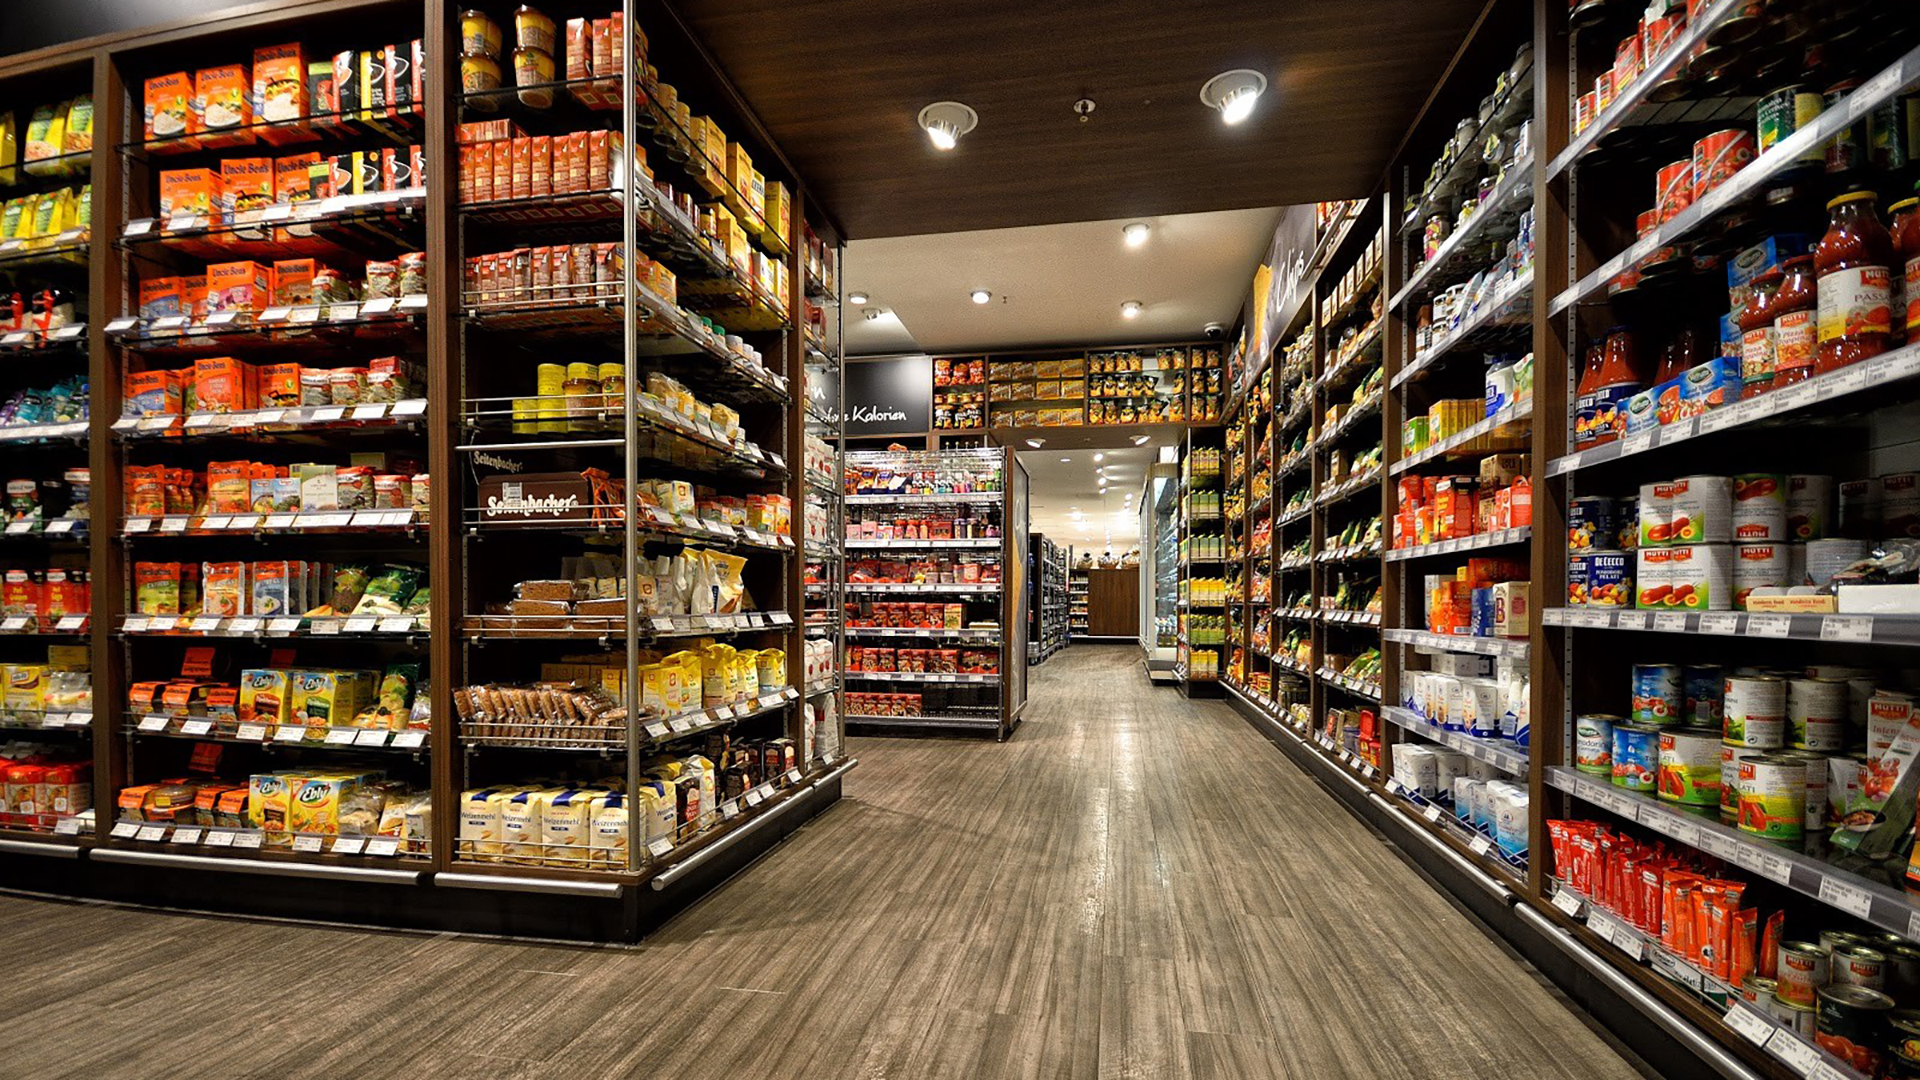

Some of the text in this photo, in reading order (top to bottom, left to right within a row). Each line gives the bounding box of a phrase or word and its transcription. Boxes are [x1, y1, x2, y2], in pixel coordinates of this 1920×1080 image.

[224, 163, 246, 174] Uncle
[852, 404, 907, 423] Kalorien
[473, 450, 522, 473] Seitenbacher
[1645, 550, 1669, 558] MUTTI
[1743, 547, 1770, 555] MUTTI
[304, 678, 326, 691] Ebly
[1873, 702, 1905, 713] MUTTI
[303, 786, 329, 803] Ebly
[591, 818, 629, 828] Weizenmeh
[1787, 955, 1813, 968] MUTTI
[1852, 962, 1878, 974] MUTTI
